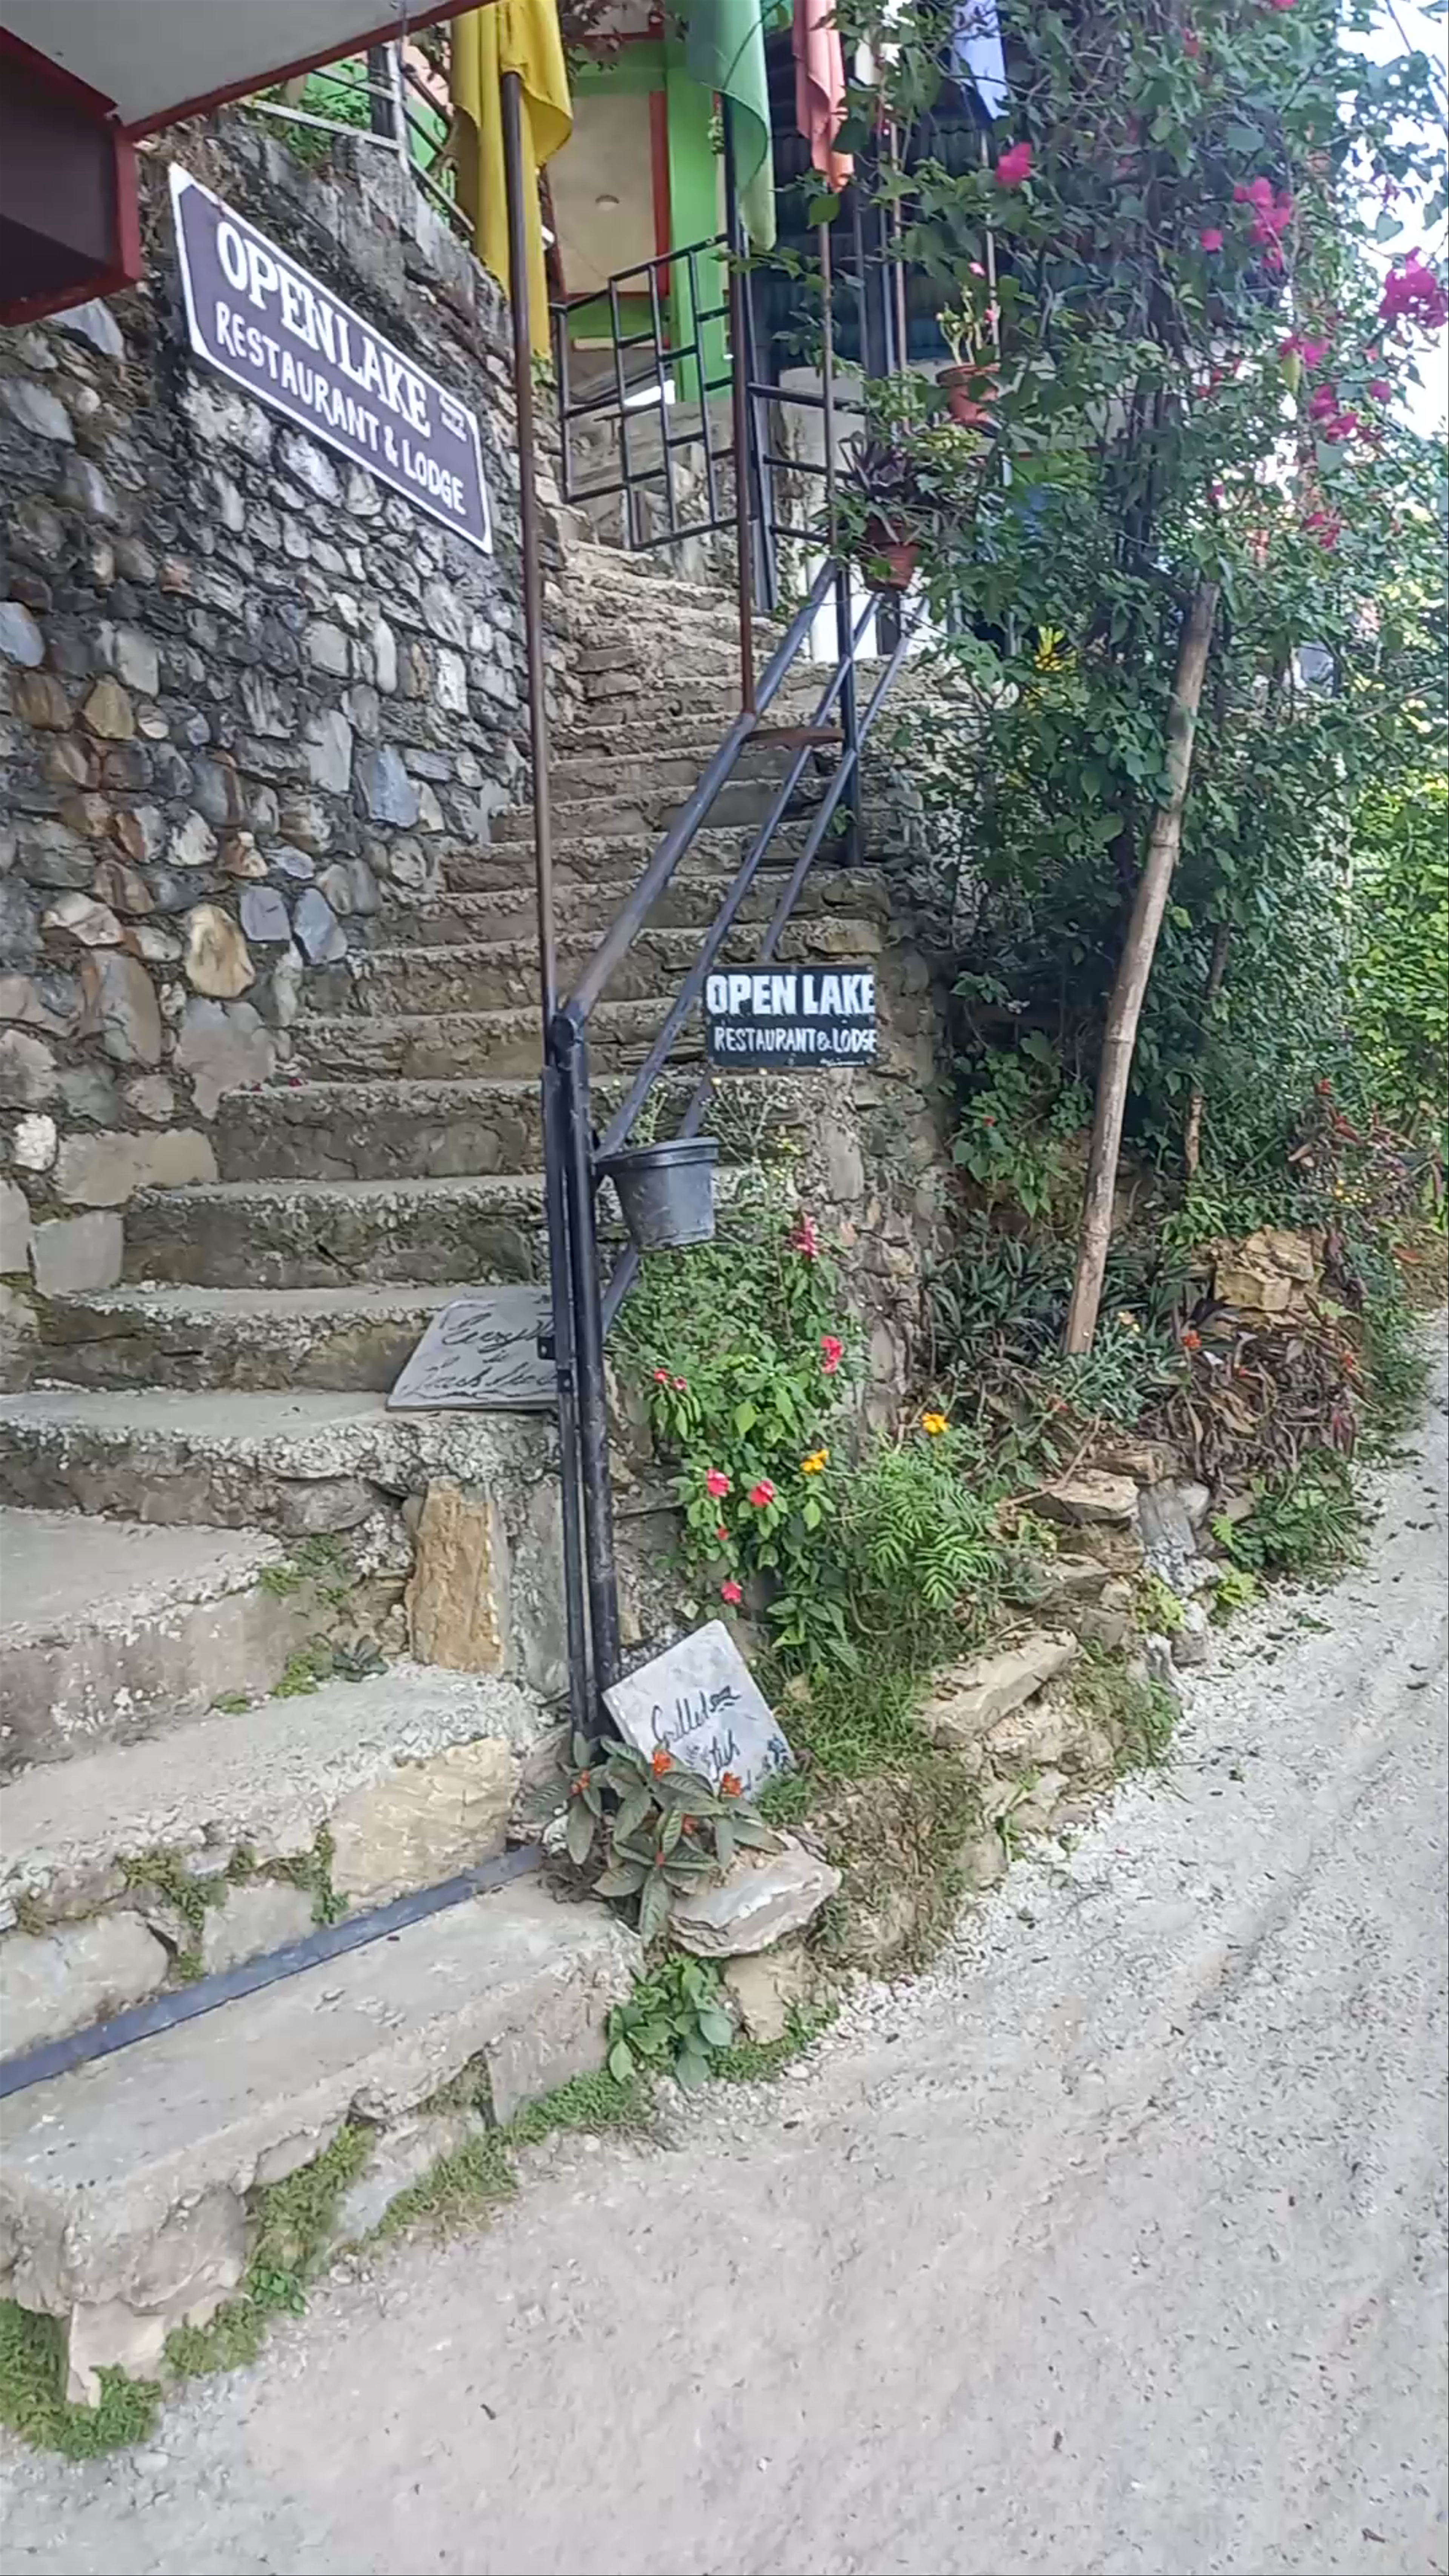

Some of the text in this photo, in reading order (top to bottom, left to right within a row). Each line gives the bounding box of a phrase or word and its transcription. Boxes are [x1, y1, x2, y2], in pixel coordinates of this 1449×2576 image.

[216, 301, 380, 451] RESTAURANT
[383, 425, 398, 468] &
[402, 438, 466, 516] LODGE
[706, 974, 875, 1015] OPEN LAKE
